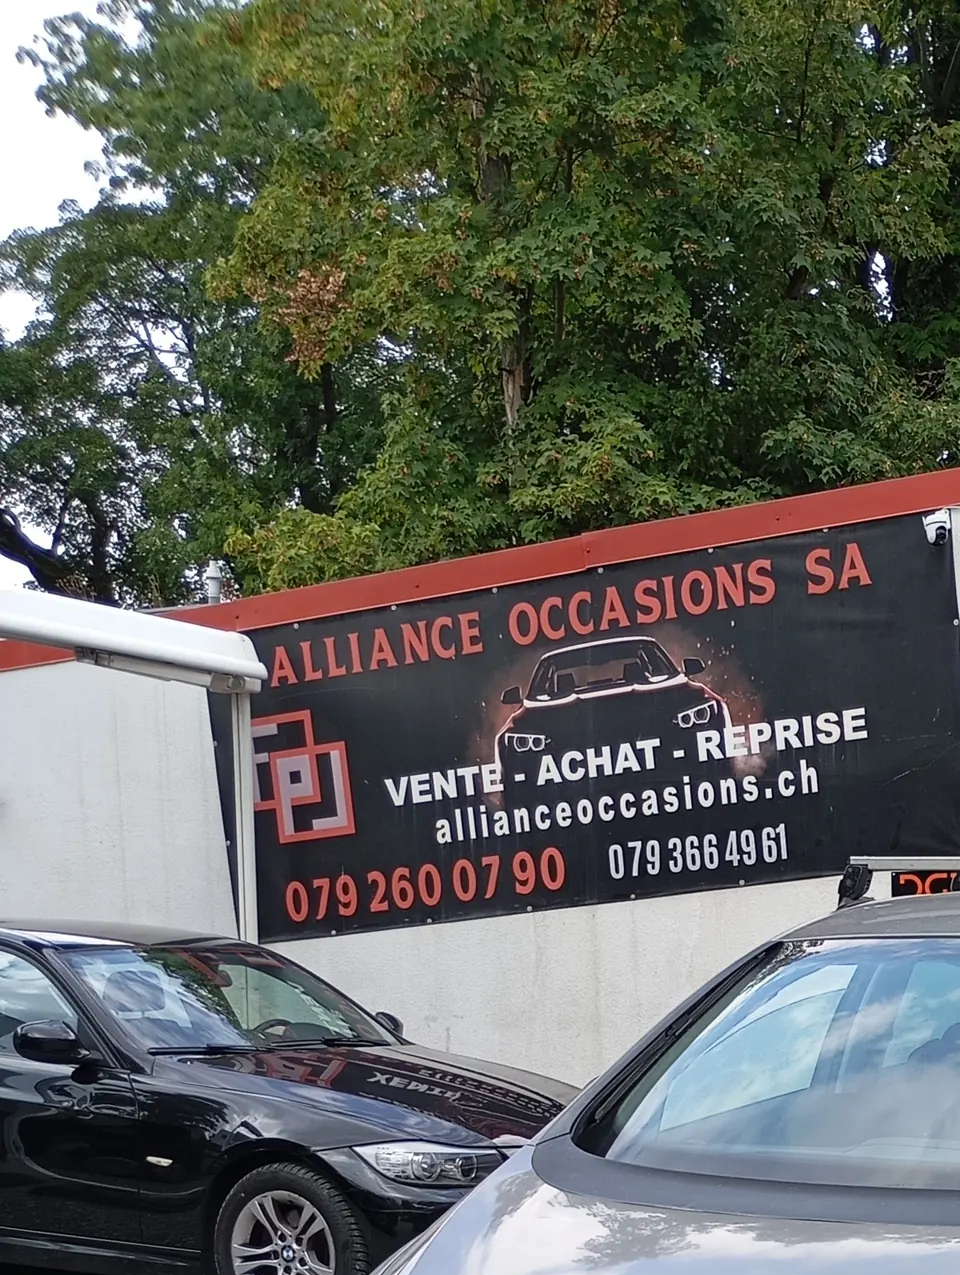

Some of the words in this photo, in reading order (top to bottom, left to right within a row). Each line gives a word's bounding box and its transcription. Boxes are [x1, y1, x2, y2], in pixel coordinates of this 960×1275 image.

[270, 611, 484, 688] ALLIANCE
[508, 558, 776, 646] OCCASIONS
[804, 542, 872, 595] SA
[384, 762, 504, 807] VENTE
[536, 738, 660, 786] ACHAT
[696, 707, 868, 762] REPRISE
[436, 759, 819, 844] allianceoccasions.ch
[285, 875, 358, 923] 079
[367, 864, 442, 913] 260
[453, 855, 500, 902] 07
[512, 847, 566, 895] 90
[608, 839, 660, 880] 079
[667, 833, 720, 874] 366
